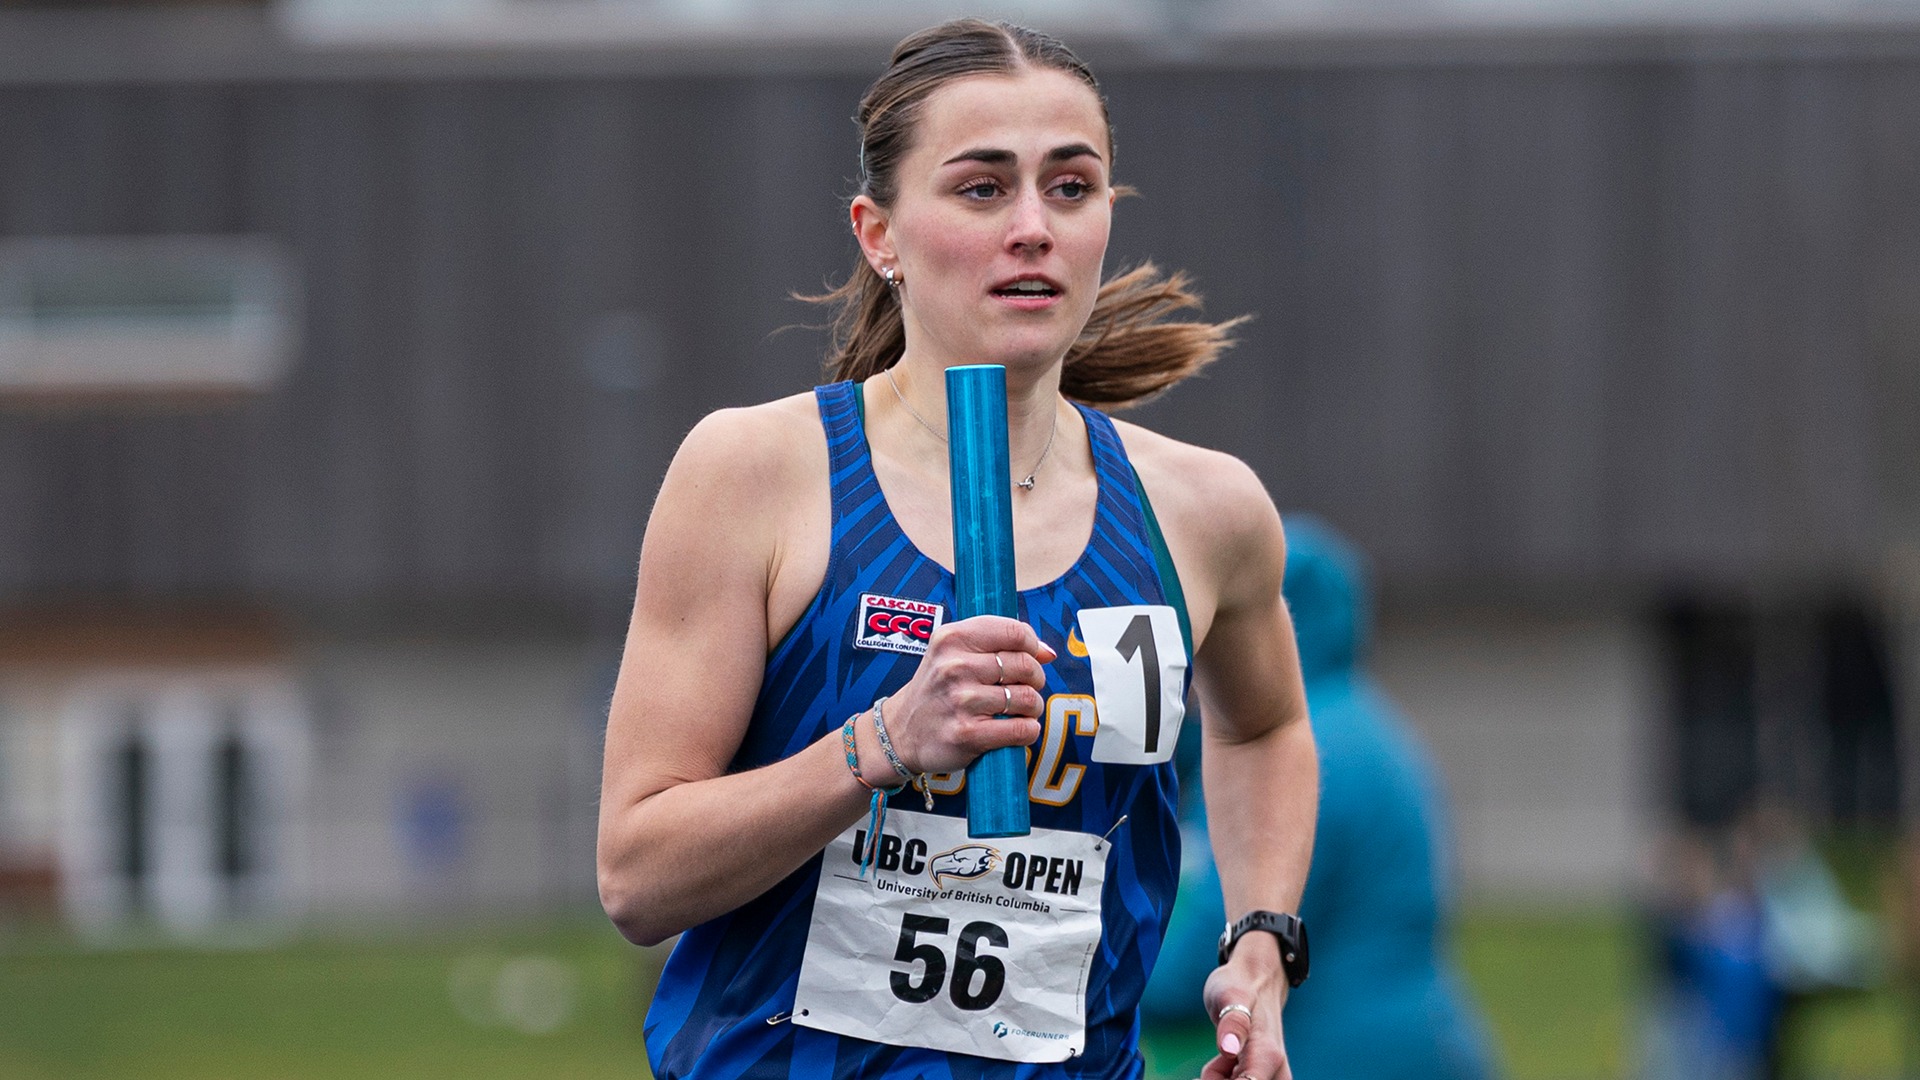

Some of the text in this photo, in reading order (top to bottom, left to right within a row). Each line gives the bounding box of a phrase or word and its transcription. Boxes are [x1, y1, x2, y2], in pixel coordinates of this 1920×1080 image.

[866, 597, 937, 615] CASCADE
[868, 612, 932, 639] CCC
[857, 640, 895, 649] COLLEGIATE
[1115, 615, 1161, 753] 1
[851, 829, 1084, 896] UBC OPEN
[877, 879, 1050, 913] University of British Columbia
[889, 912, 1009, 1011] 56
